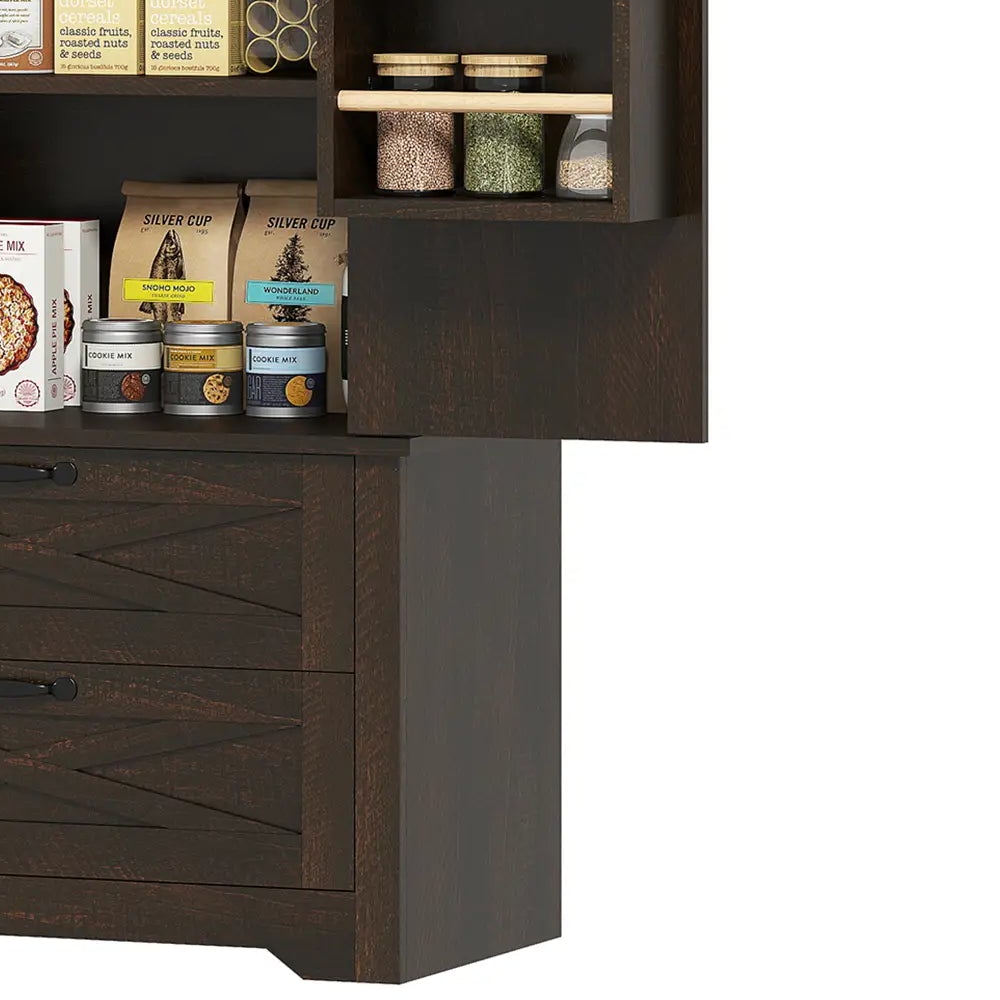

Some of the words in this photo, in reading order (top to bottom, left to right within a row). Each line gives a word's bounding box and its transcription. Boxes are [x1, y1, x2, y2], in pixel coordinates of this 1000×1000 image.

[59, 10, 120, 25] cereals
[150, 10, 212, 25] cereals
[60, 27, 97, 36] classic
[99, 27, 132, 38] fruits,
[151, 28, 188, 37] classic
[60, 39, 100, 48] roasted
[103, 40, 128, 48] nuts
[151, 40, 192, 48] roasted
[195, 41, 220, 49] nuts
[60, 49, 69, 58] &
[71, 50, 102, 59] seeds
[151, 50, 160, 60] &
[162, 51, 193, 60] seeds
[143, 214, 184, 226] SILVER
[187, 215, 212, 226] CUP
[267, 216, 308, 229] SILVER
[310, 218, 336, 230] CUP
[6, 241, 25, 252] MIX
[142, 284, 171, 292] SNOHO
[172, 285, 196, 293] MOJO
[263, 286, 319, 295] WONDERLAND
[88, 351, 115, 359] COOKIE
[252, 355, 280, 363] COOKIE
